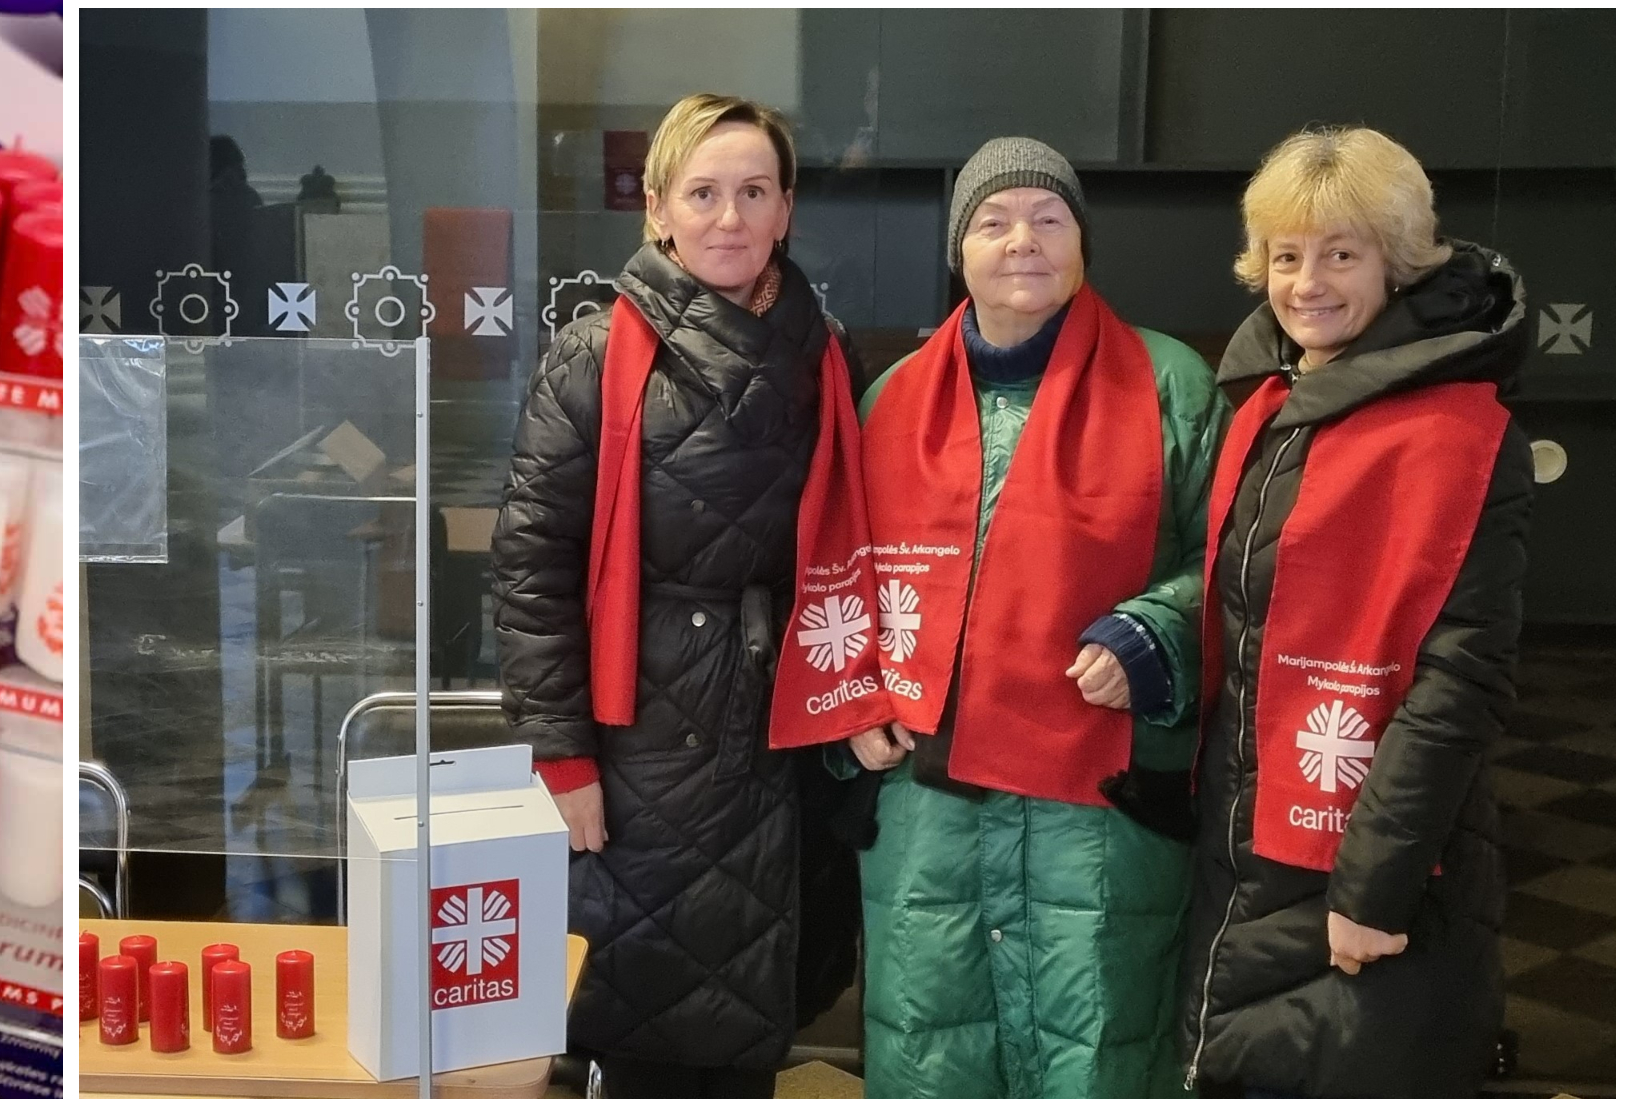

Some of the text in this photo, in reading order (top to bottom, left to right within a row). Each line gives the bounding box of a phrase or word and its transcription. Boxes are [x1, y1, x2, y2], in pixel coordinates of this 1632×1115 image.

[899, 541, 911, 555] Šv.
[911, 544, 960, 557] Arkangelo
[805, 564, 831, 576] polės
[892, 562, 930, 574] parapijos
[802, 582, 827, 594] ykolo
[806, 675, 879, 715] caritas
[434, 977, 514, 1006] caritas
